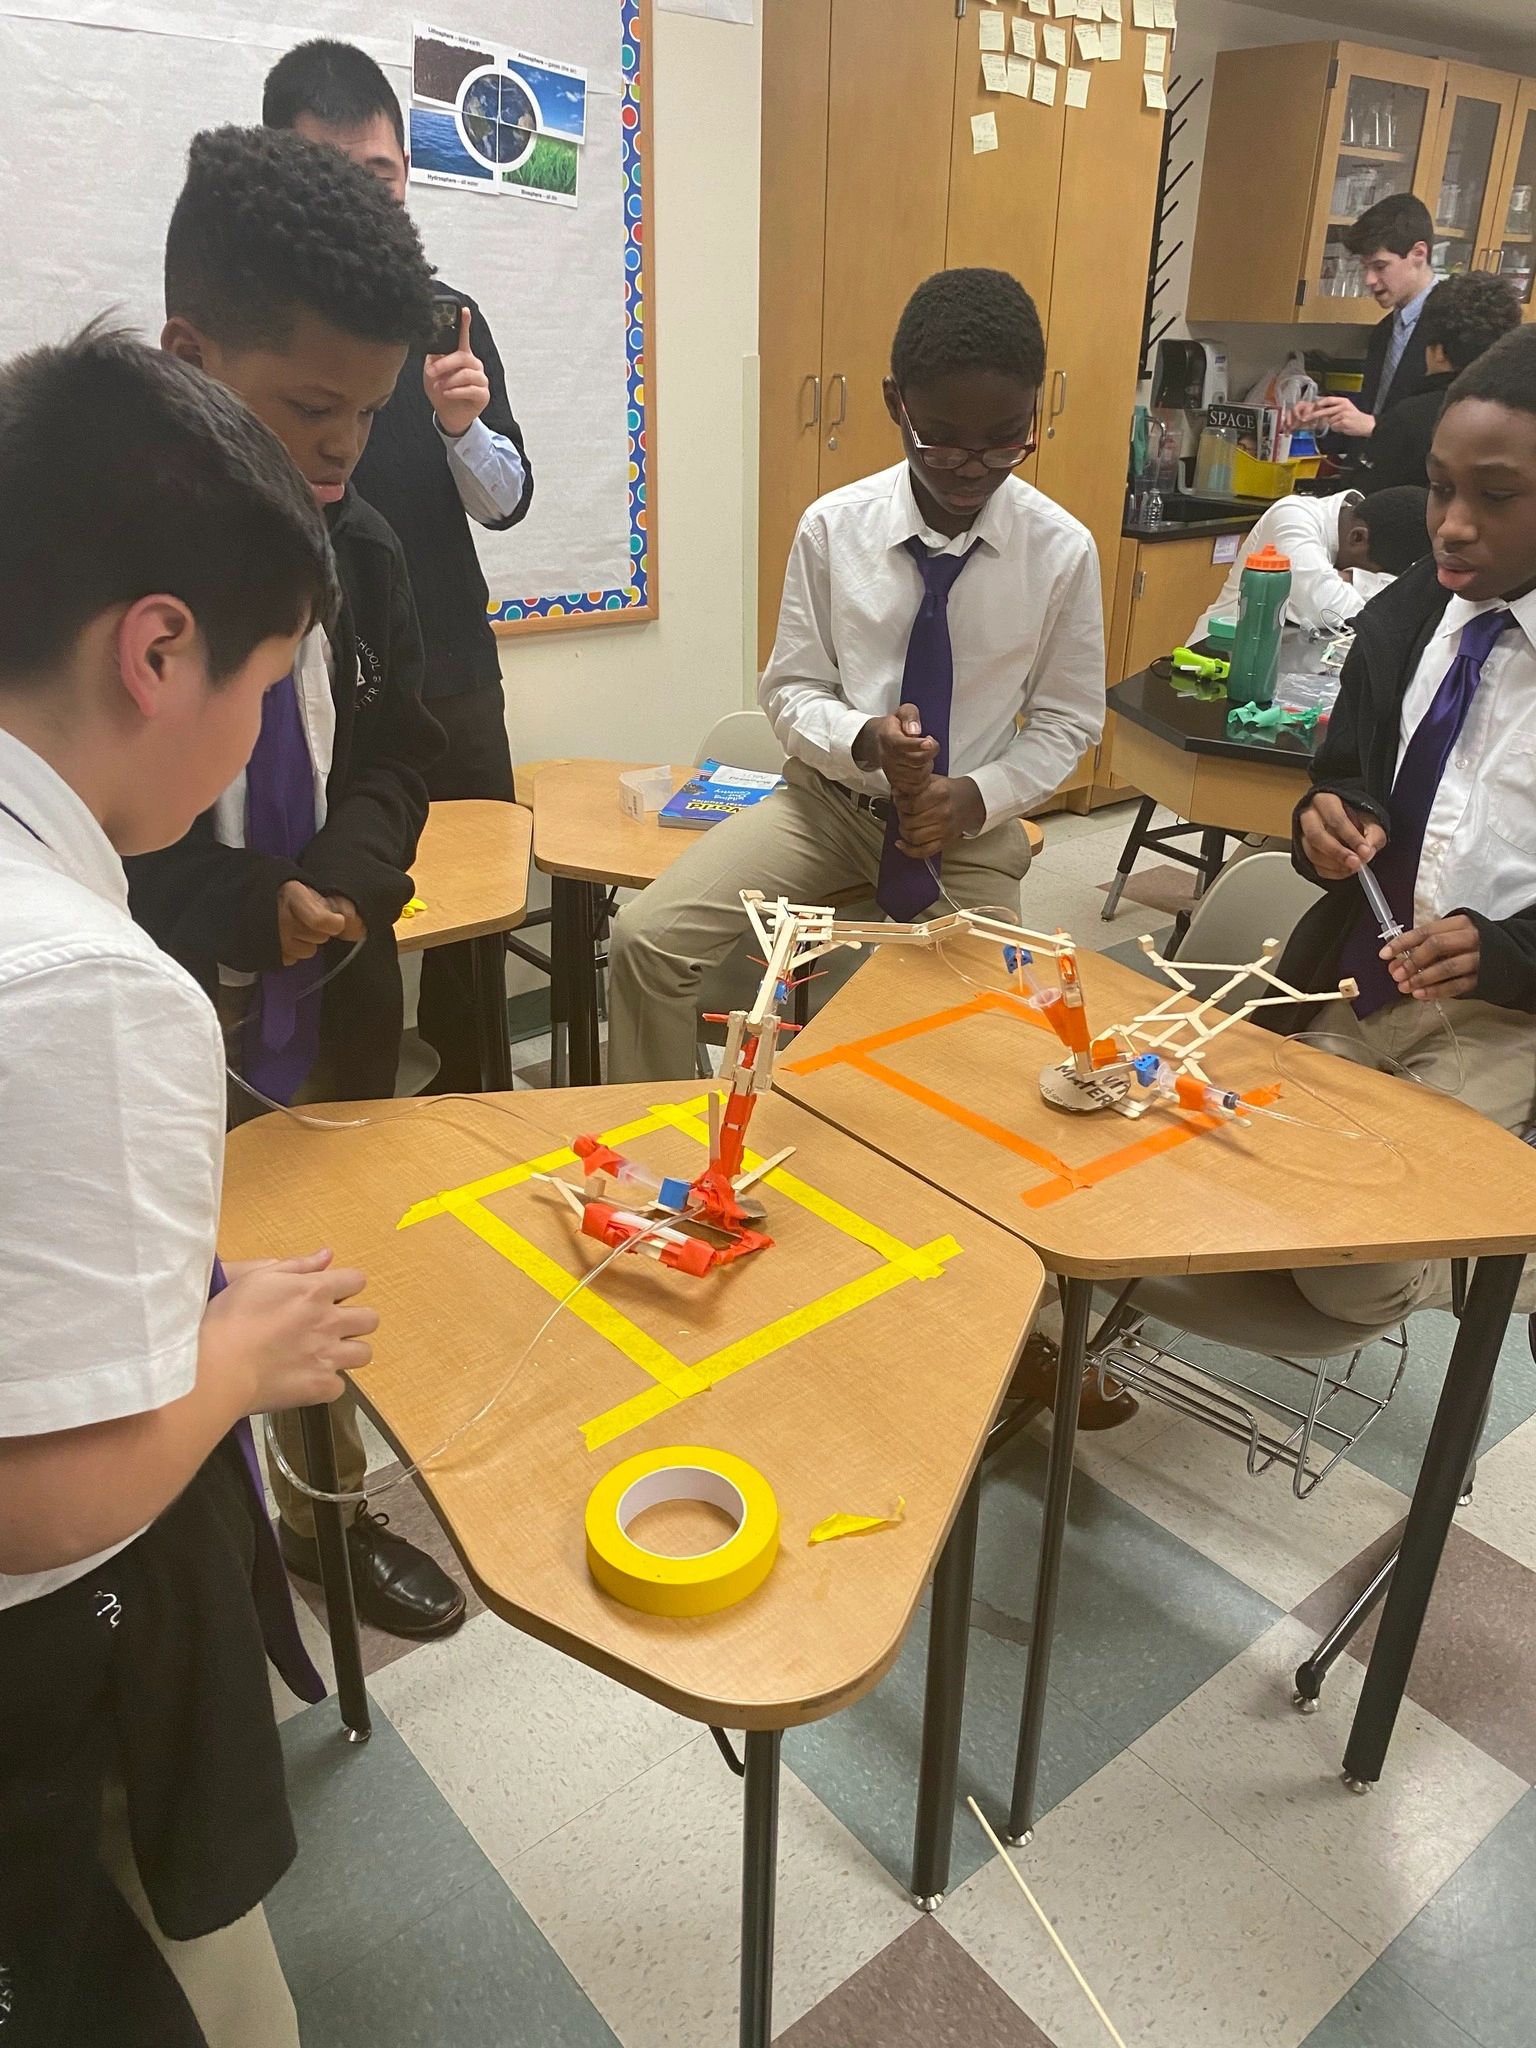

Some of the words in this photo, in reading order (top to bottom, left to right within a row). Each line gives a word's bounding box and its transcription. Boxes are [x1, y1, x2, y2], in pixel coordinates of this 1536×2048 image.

[428, 26, 453, 39] Lithosphere
[518, 52, 543, 64] Atmosphere
[427, 173, 457, 184] Hydrosphere
[1209, 411, 1255, 429] SPACE
